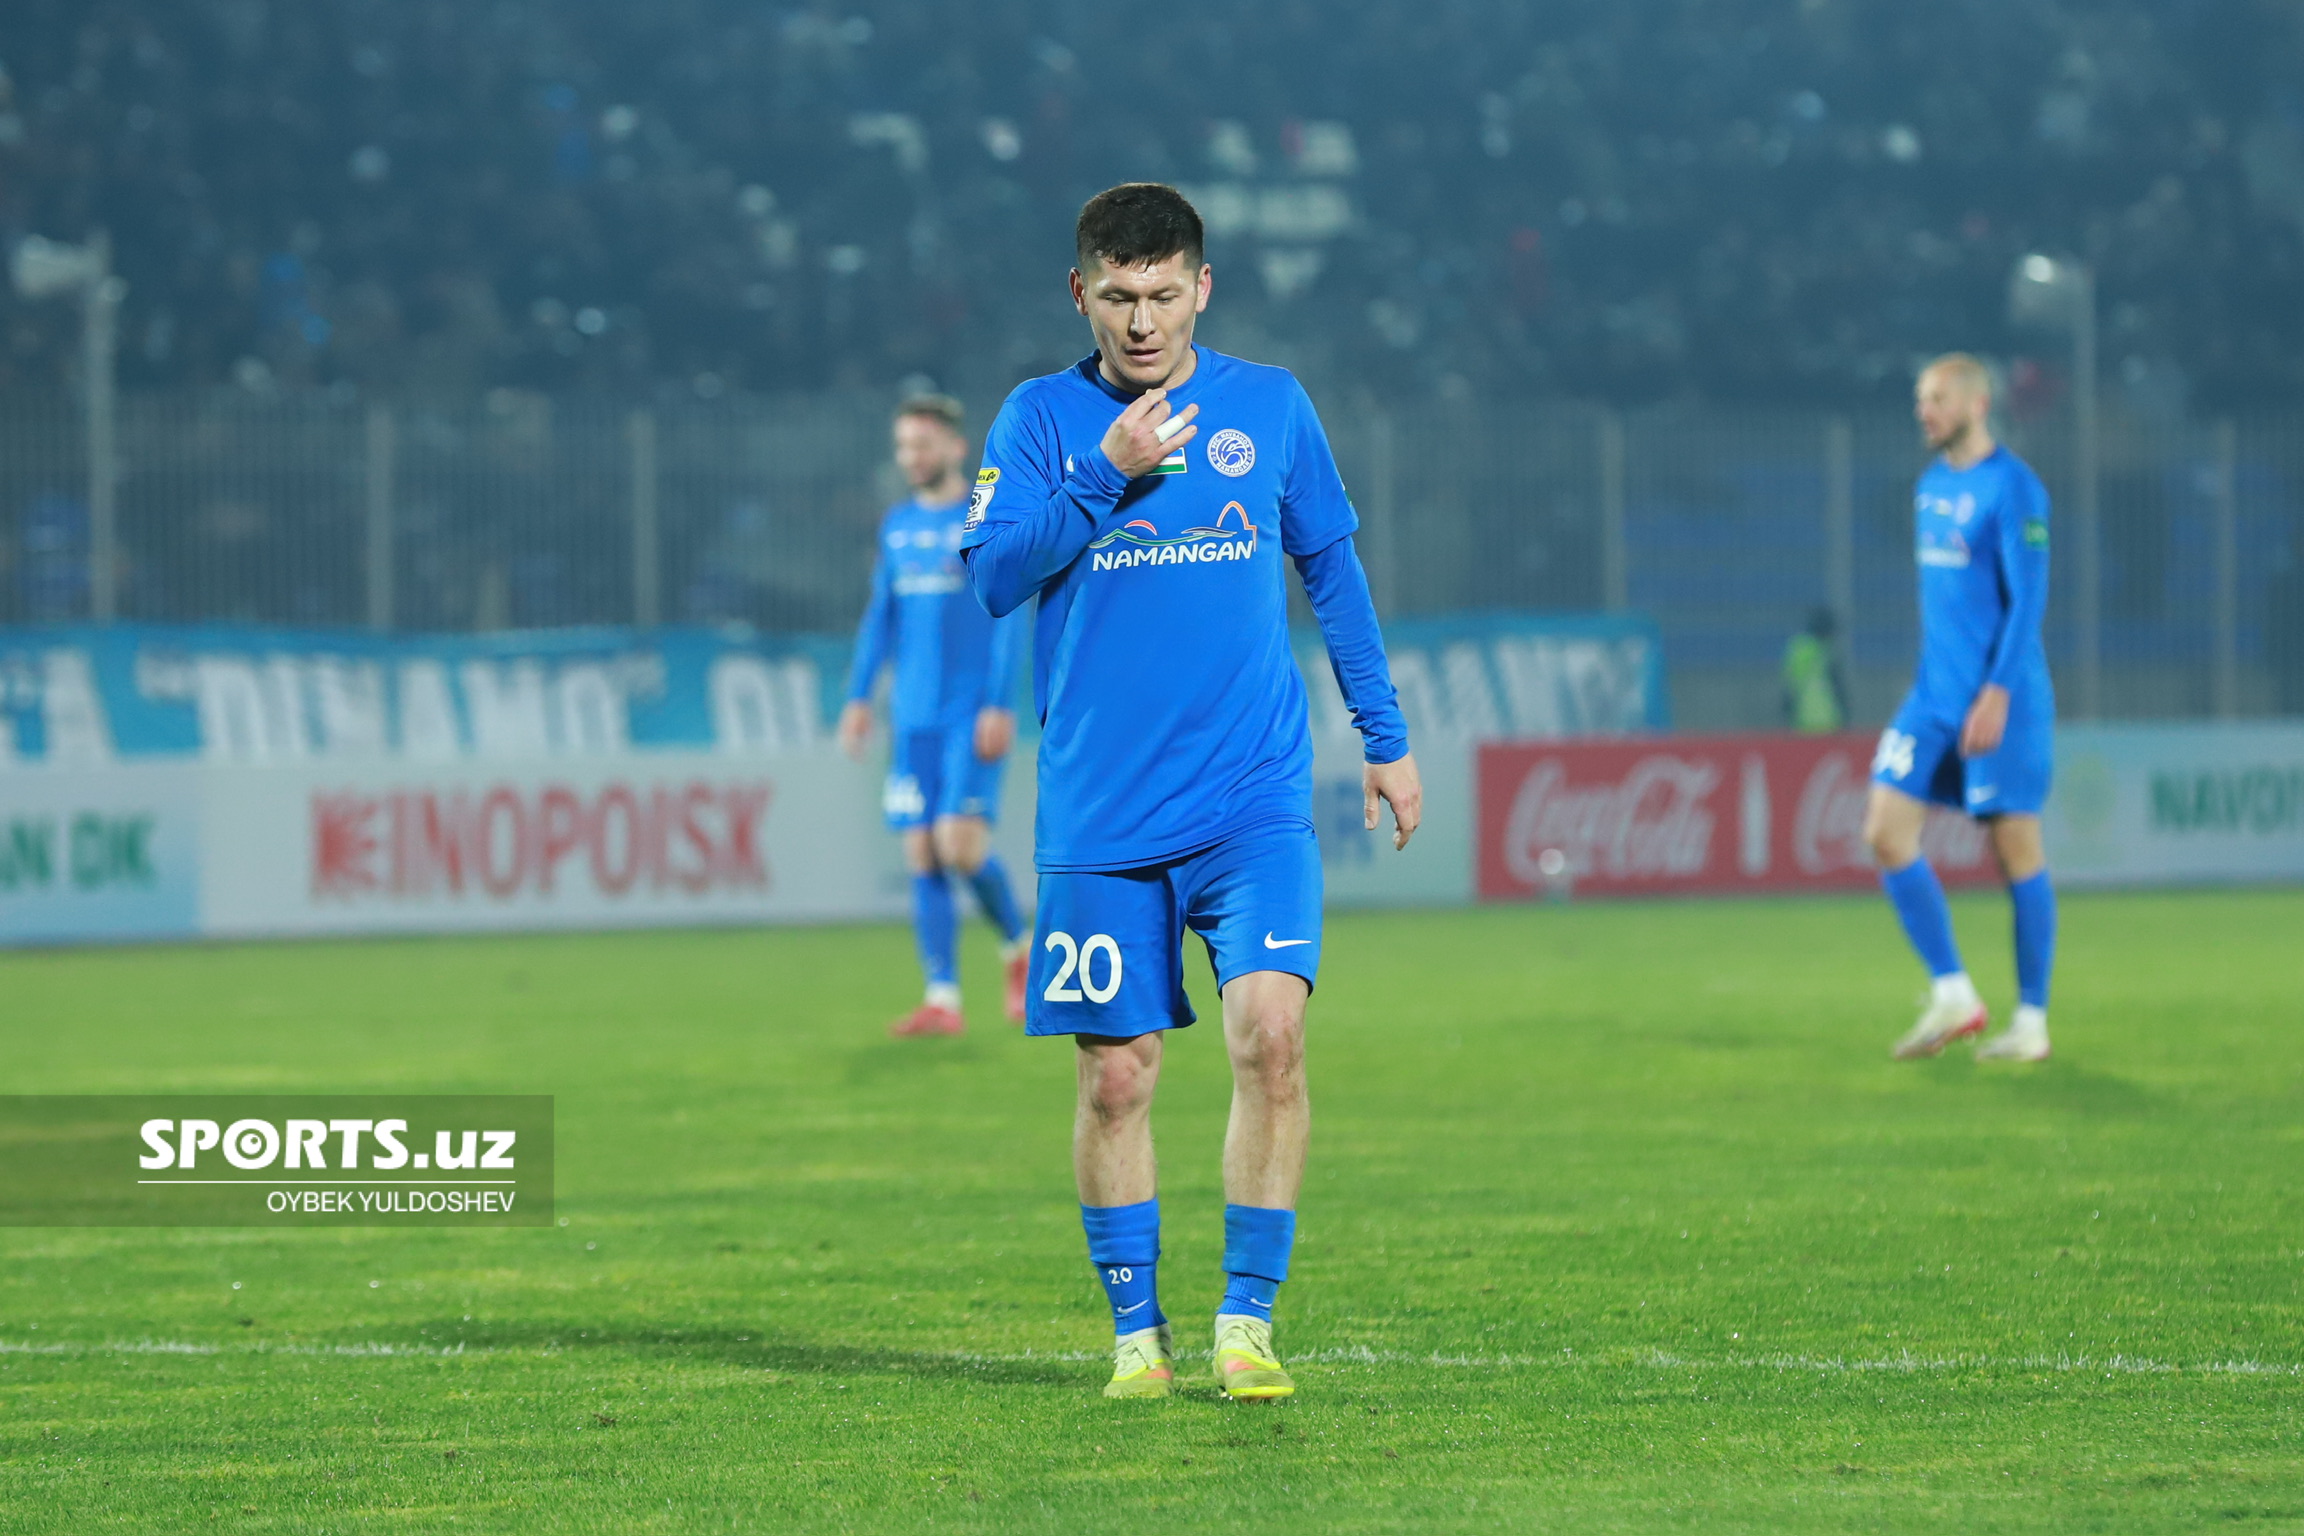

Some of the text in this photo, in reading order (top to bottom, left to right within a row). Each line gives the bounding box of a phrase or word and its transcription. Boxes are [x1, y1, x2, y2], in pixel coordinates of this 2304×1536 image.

[1092, 540, 1254, 572] NAMANGAN
[1043, 931, 1123, 1004] 20
[1108, 1267, 1133, 1285] 20
